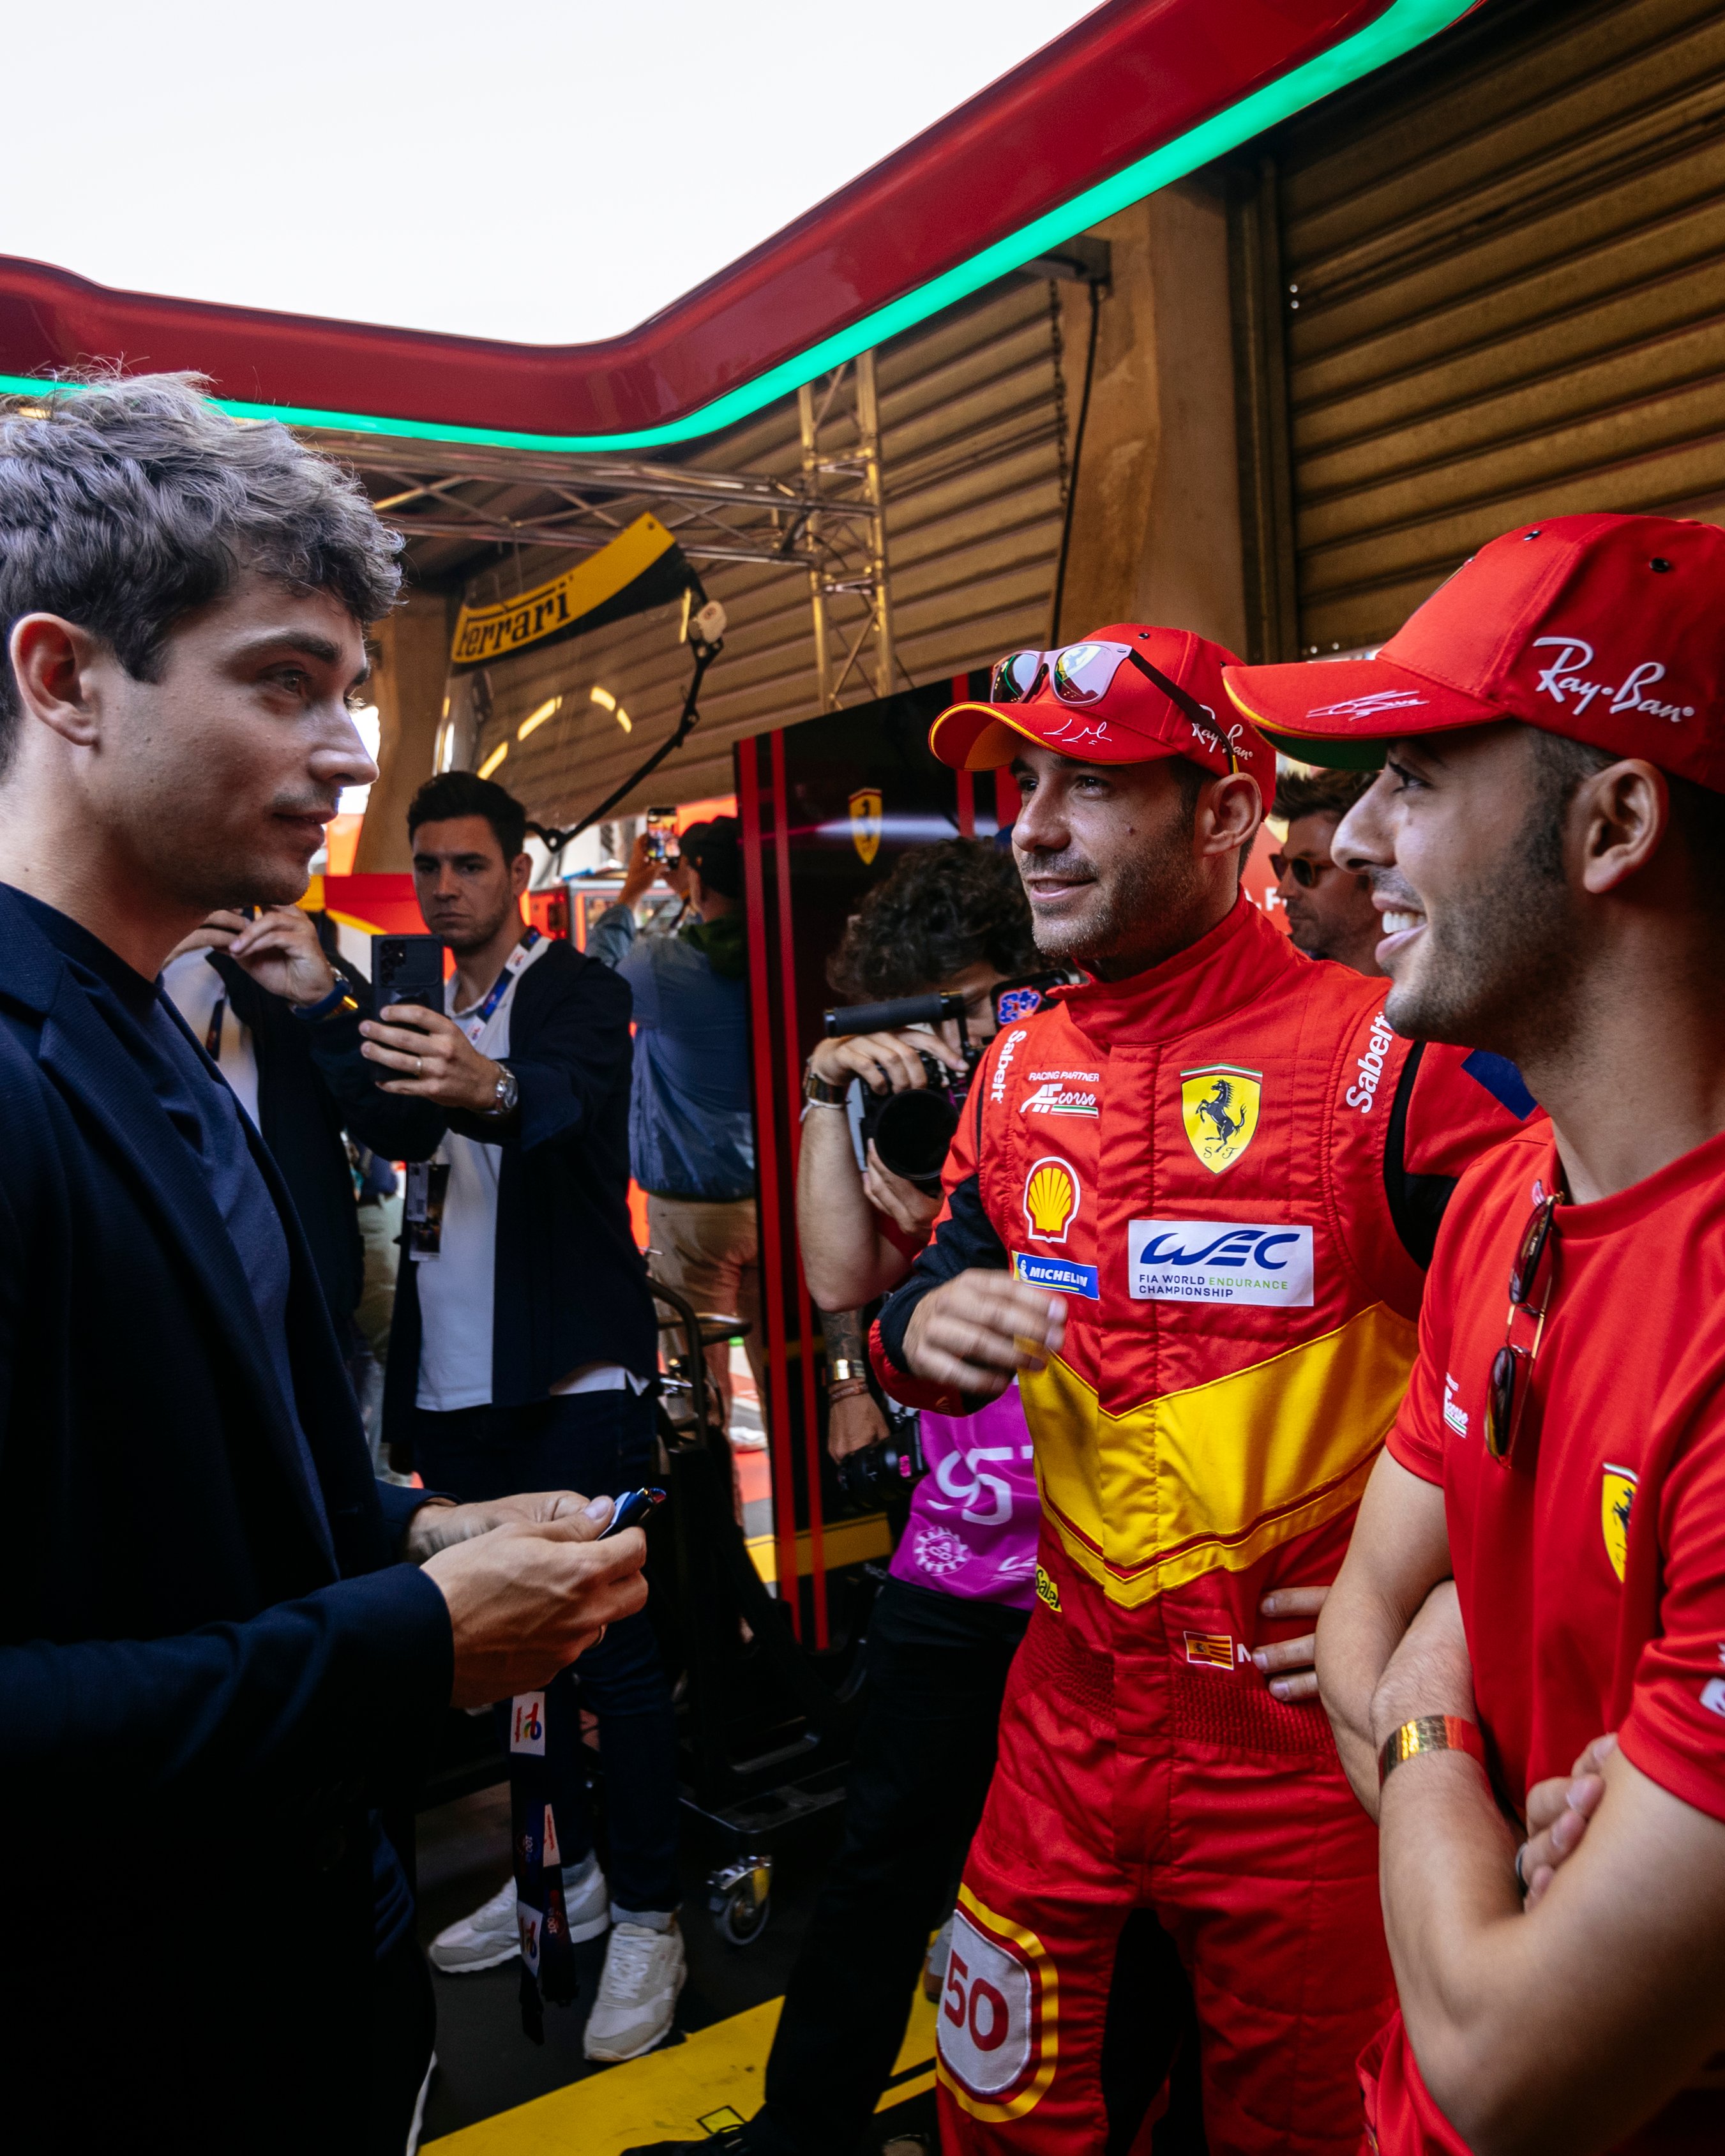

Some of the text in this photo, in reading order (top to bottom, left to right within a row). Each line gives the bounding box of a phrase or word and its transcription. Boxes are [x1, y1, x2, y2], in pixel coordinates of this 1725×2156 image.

[991, 1030, 1027, 1104] Sabelt
[1028, 1071, 1100, 1082] RACING PARTNER
[1346, 1012, 1394, 1113] Sabelt
[1140, 1229, 1301, 1270] WEC
[1029, 1266, 1088, 1288] MICHELIN
[1139, 1274, 1288, 1290] FIA WORLD ENDURANCE
[1139, 1285, 1233, 1297] CHAMPIONSHIP
[944, 1948, 1009, 2052] 50
